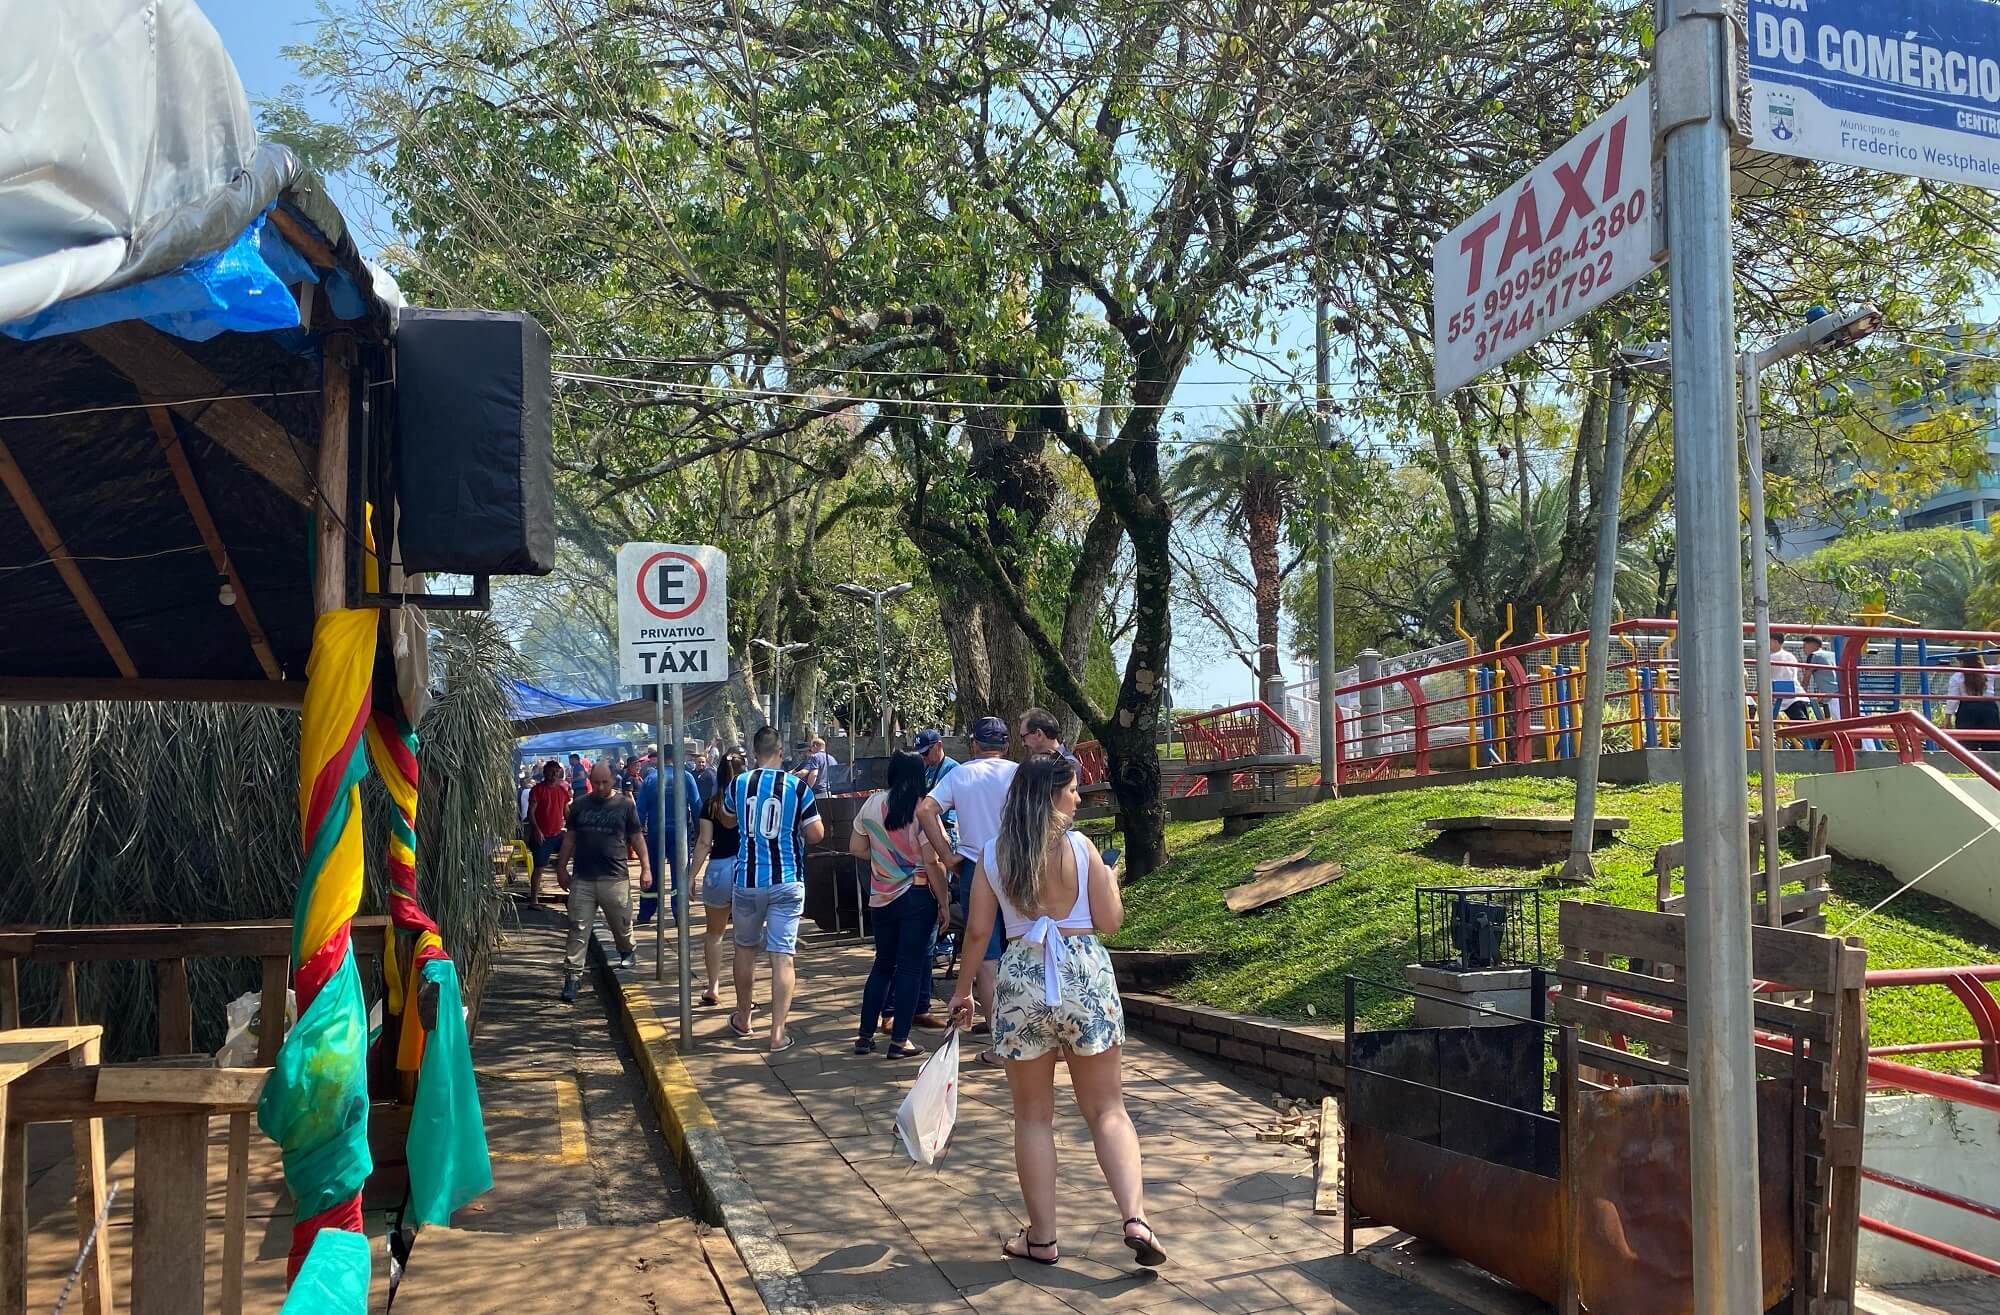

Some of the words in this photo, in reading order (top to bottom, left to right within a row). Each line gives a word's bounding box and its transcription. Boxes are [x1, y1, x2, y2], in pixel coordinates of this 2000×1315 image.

[1755, 12, 1806, 64] DO
[1817, 24, 2000, 103] COMÉRCIO
[1840, 132, 1917, 160] Frederico
[1889, 128, 1900, 137] de
[1460, 115, 1628, 296] TÁXI
[1448, 302, 1476, 344] 55
[1483, 188, 1646, 321] 99958-4380
[1473, 249, 1614, 362] 3744-1792
[658, 565, 685, 605] E
[640, 626, 705, 639] PRIVATIVO
[638, 645, 708, 674] TÁXI
[746, 795, 782, 840] 10
